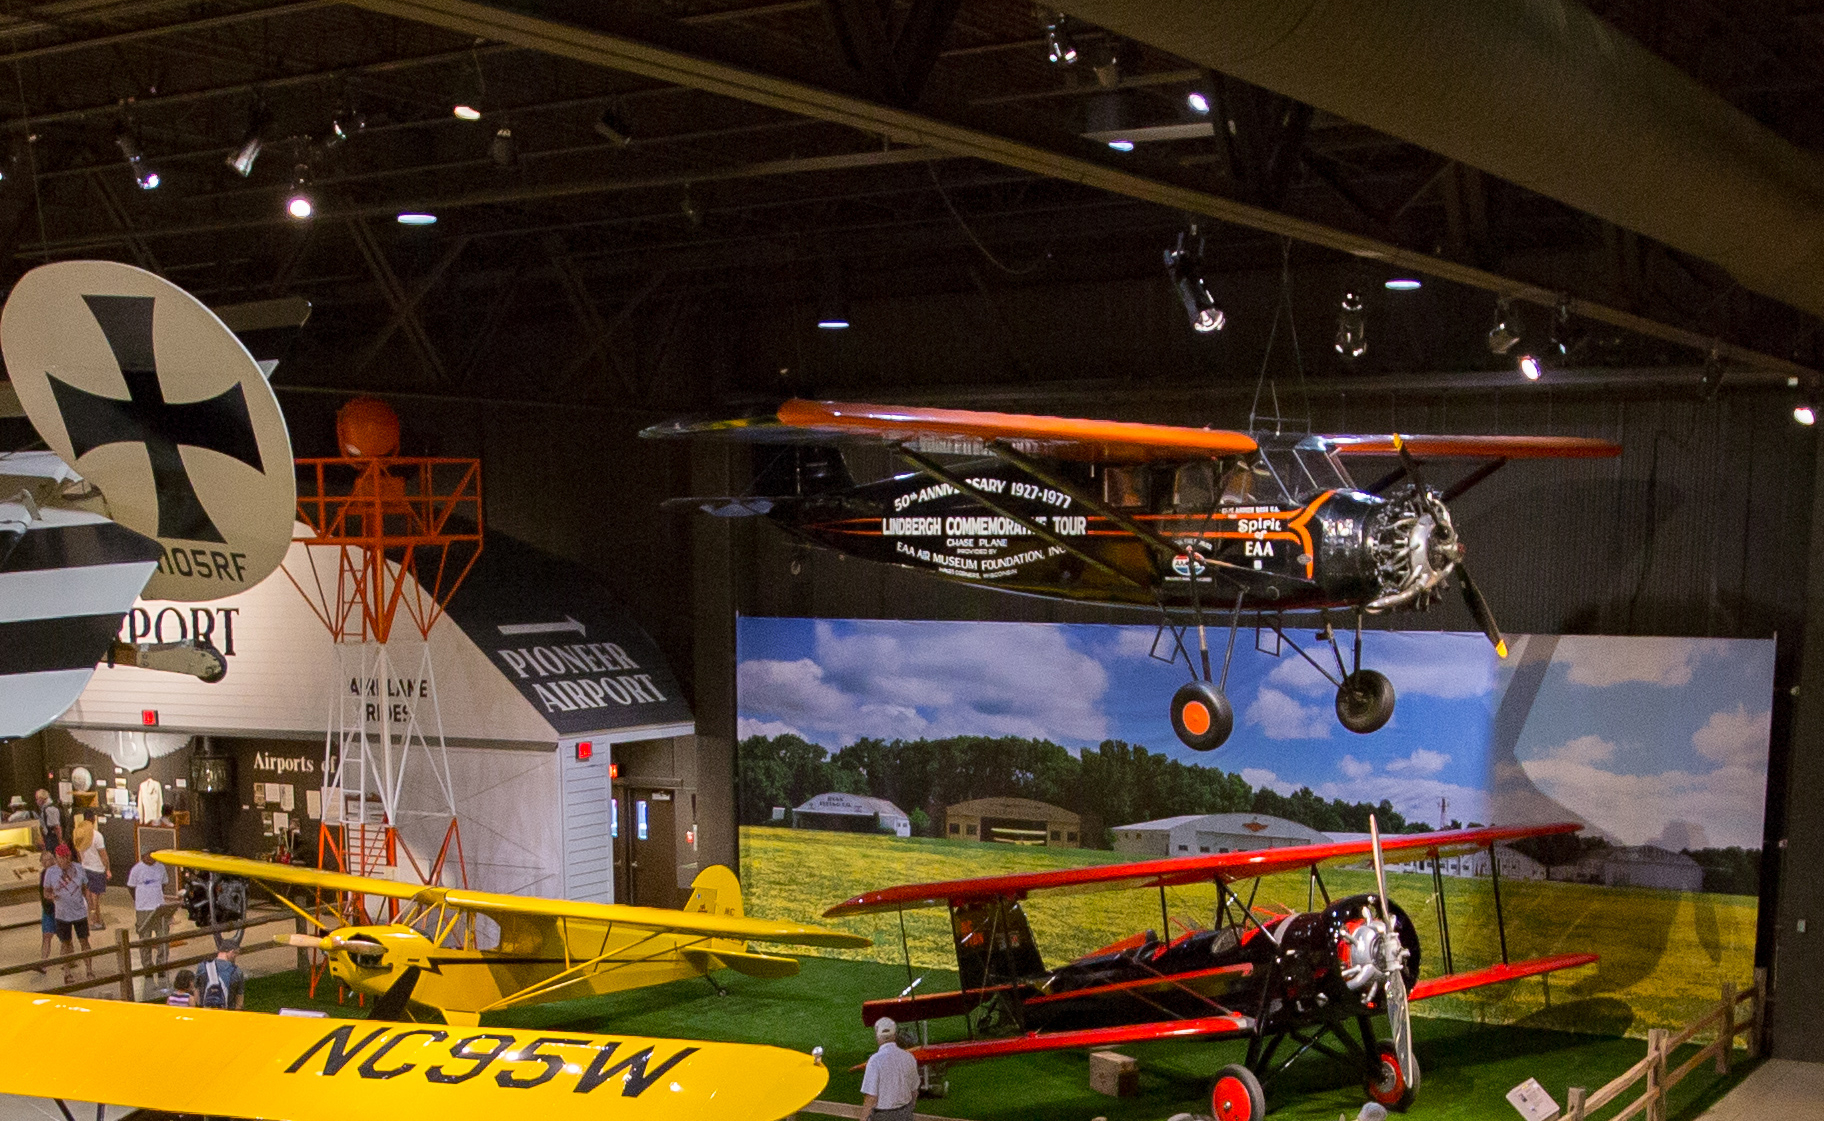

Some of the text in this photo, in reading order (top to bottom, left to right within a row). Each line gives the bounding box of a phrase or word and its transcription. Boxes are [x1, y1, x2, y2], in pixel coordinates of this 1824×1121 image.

[918, 478, 1007, 503] ANNIVSARY
[882, 516, 1087, 536] LINDBERGH COMMEMORA TOUR
[1238, 517, 1282, 534] Spirit
[1254, 529, 1267, 540] of
[946, 538, 1008, 547] CHASE PLANE
[1244, 541, 1274, 557] EAA
[157, 547, 247, 583] 105RF
[896, 541, 915, 557] EAA
[916, 549, 931, 562] AIR
[932, 553, 978, 570] MUSEUM
[498, 642, 640, 678] PIONEER
[350, 677, 428, 698] ARLANE
[532, 674, 667, 713] AIRPORT
[253, 750, 338, 774] Airports of
[284, 1023, 702, 1099] NC95W
